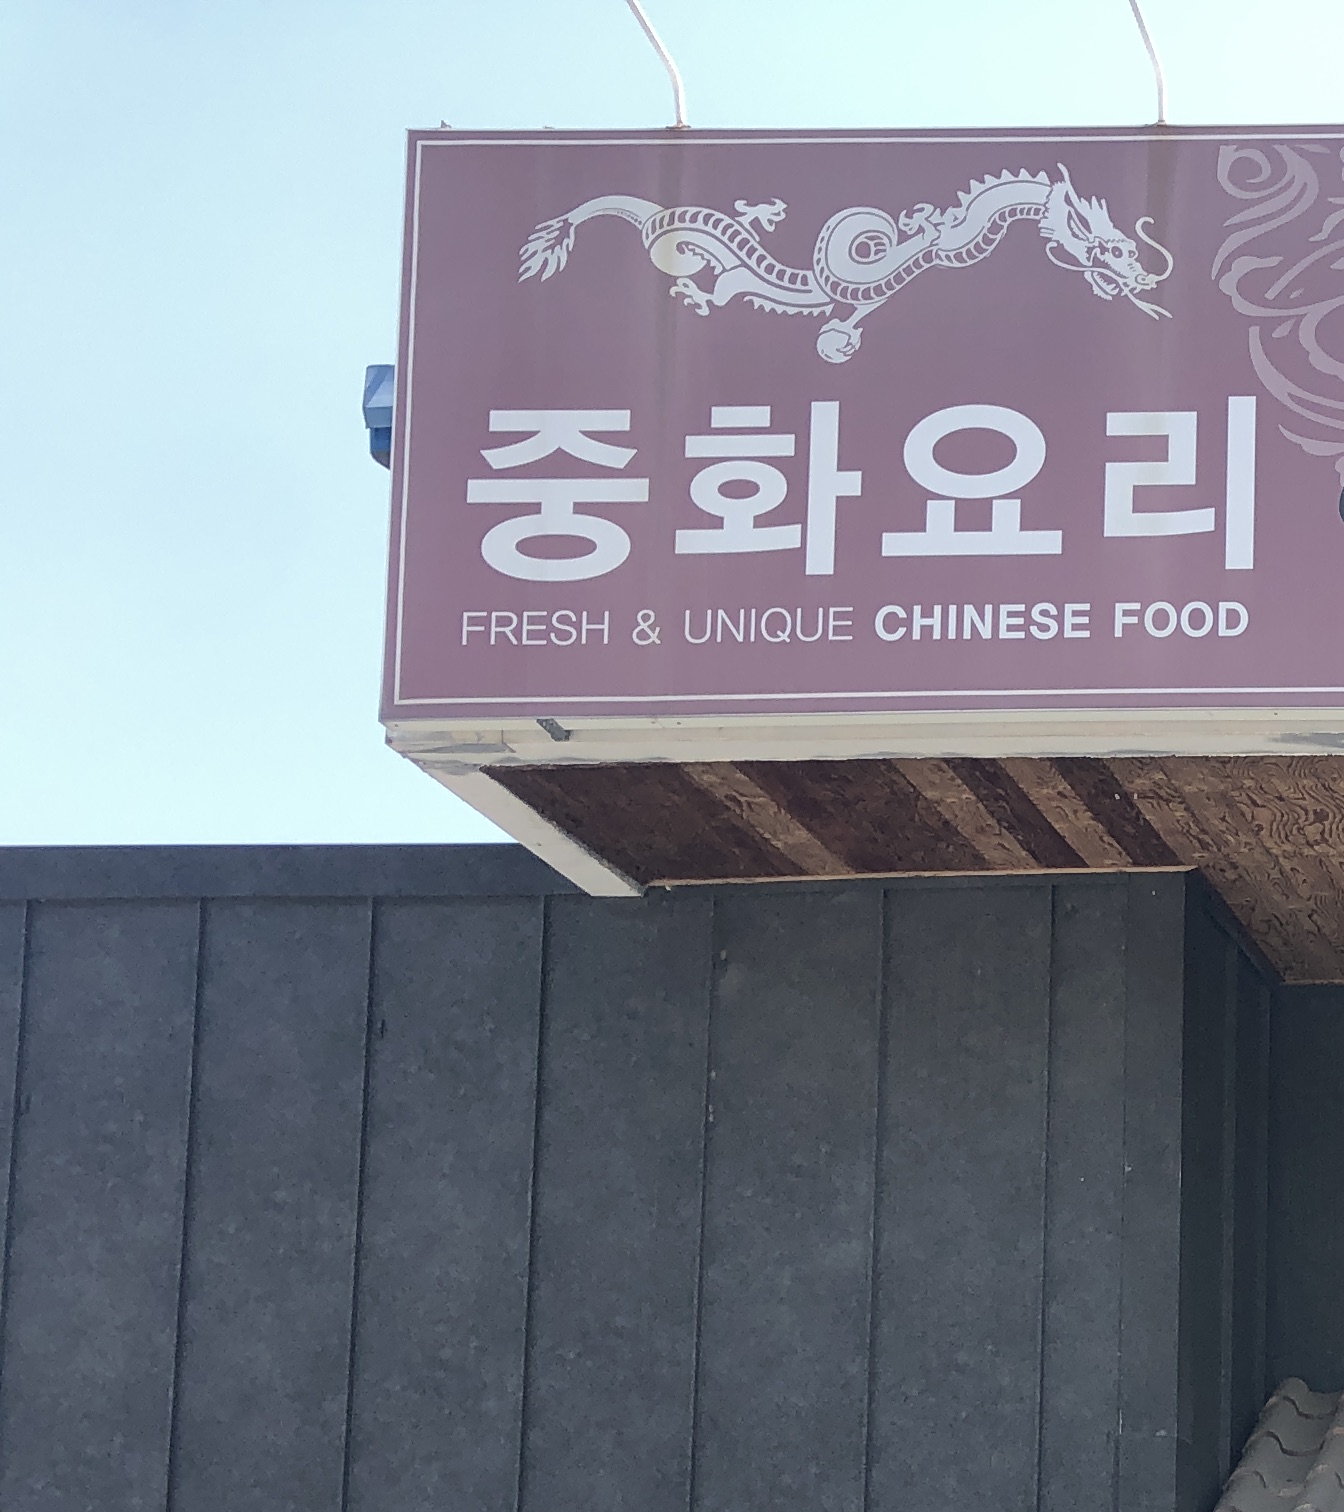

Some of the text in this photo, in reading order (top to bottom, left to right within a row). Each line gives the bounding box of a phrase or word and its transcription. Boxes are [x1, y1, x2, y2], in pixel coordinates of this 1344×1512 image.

[465, 395, 1256, 582] 중화요리
[460, 600, 1250, 646] FRESH & UNIQUE CHINESE FOOD
